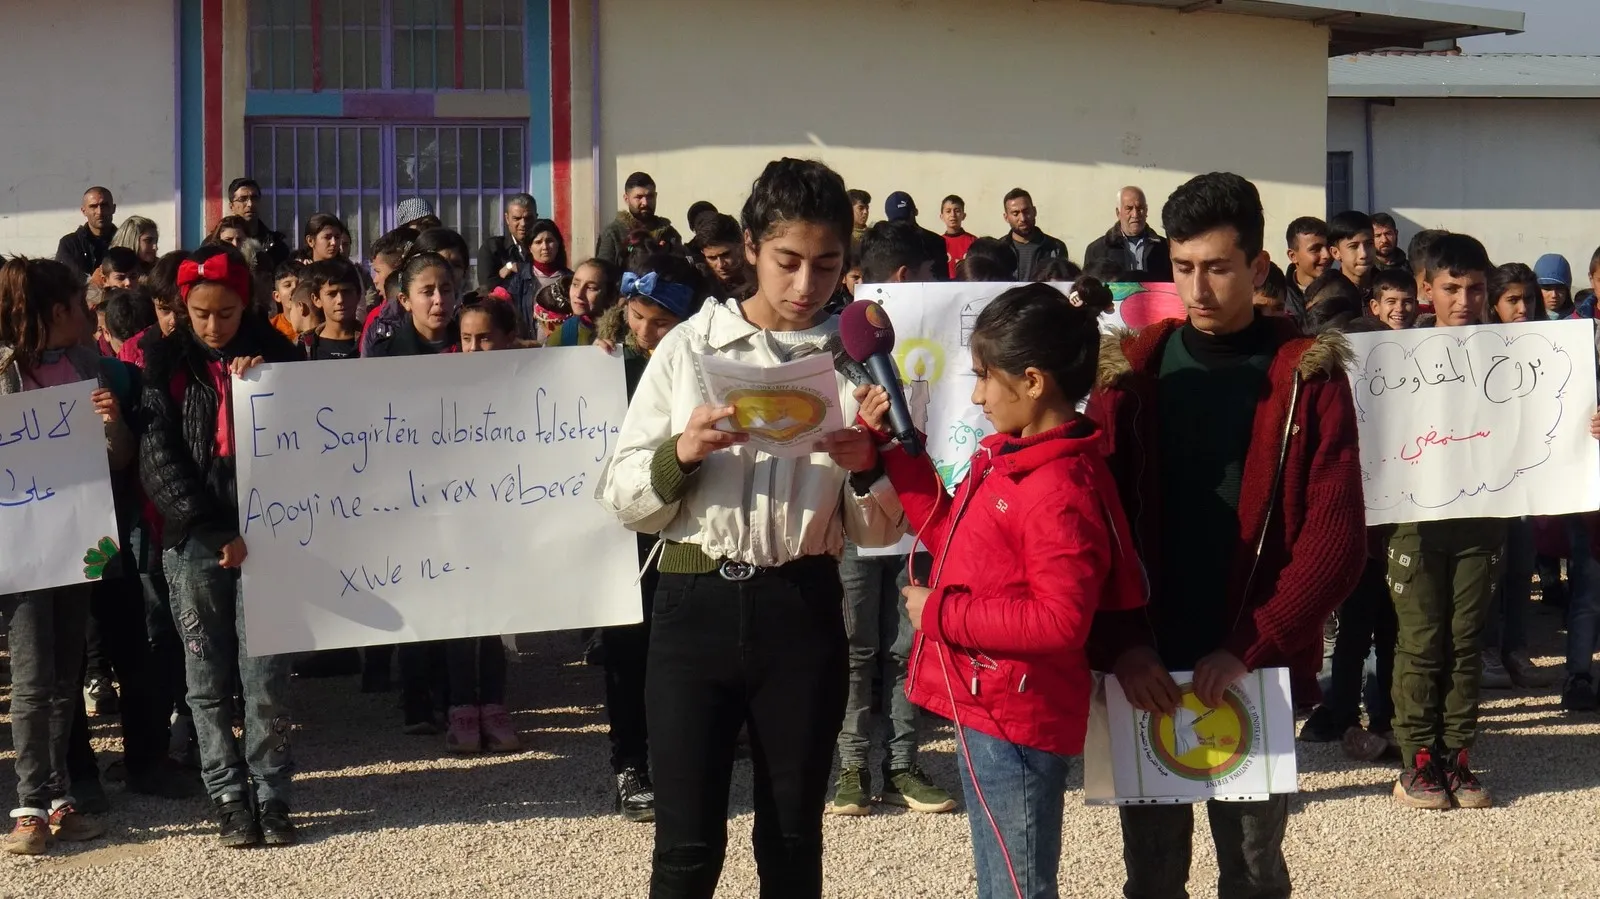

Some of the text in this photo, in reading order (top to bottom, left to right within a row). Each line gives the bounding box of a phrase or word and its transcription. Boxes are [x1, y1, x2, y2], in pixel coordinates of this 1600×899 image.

[1369, 347, 1544, 403] بروح المقاومة
[48, 400, 76, 438] لا
[250, 392, 300, 458] Em
[431, 397, 526, 445] dibistana
[535, 387, 620, 462] felsefeya
[409, 470, 427, 507] li
[441, 478, 477, 503] rex
